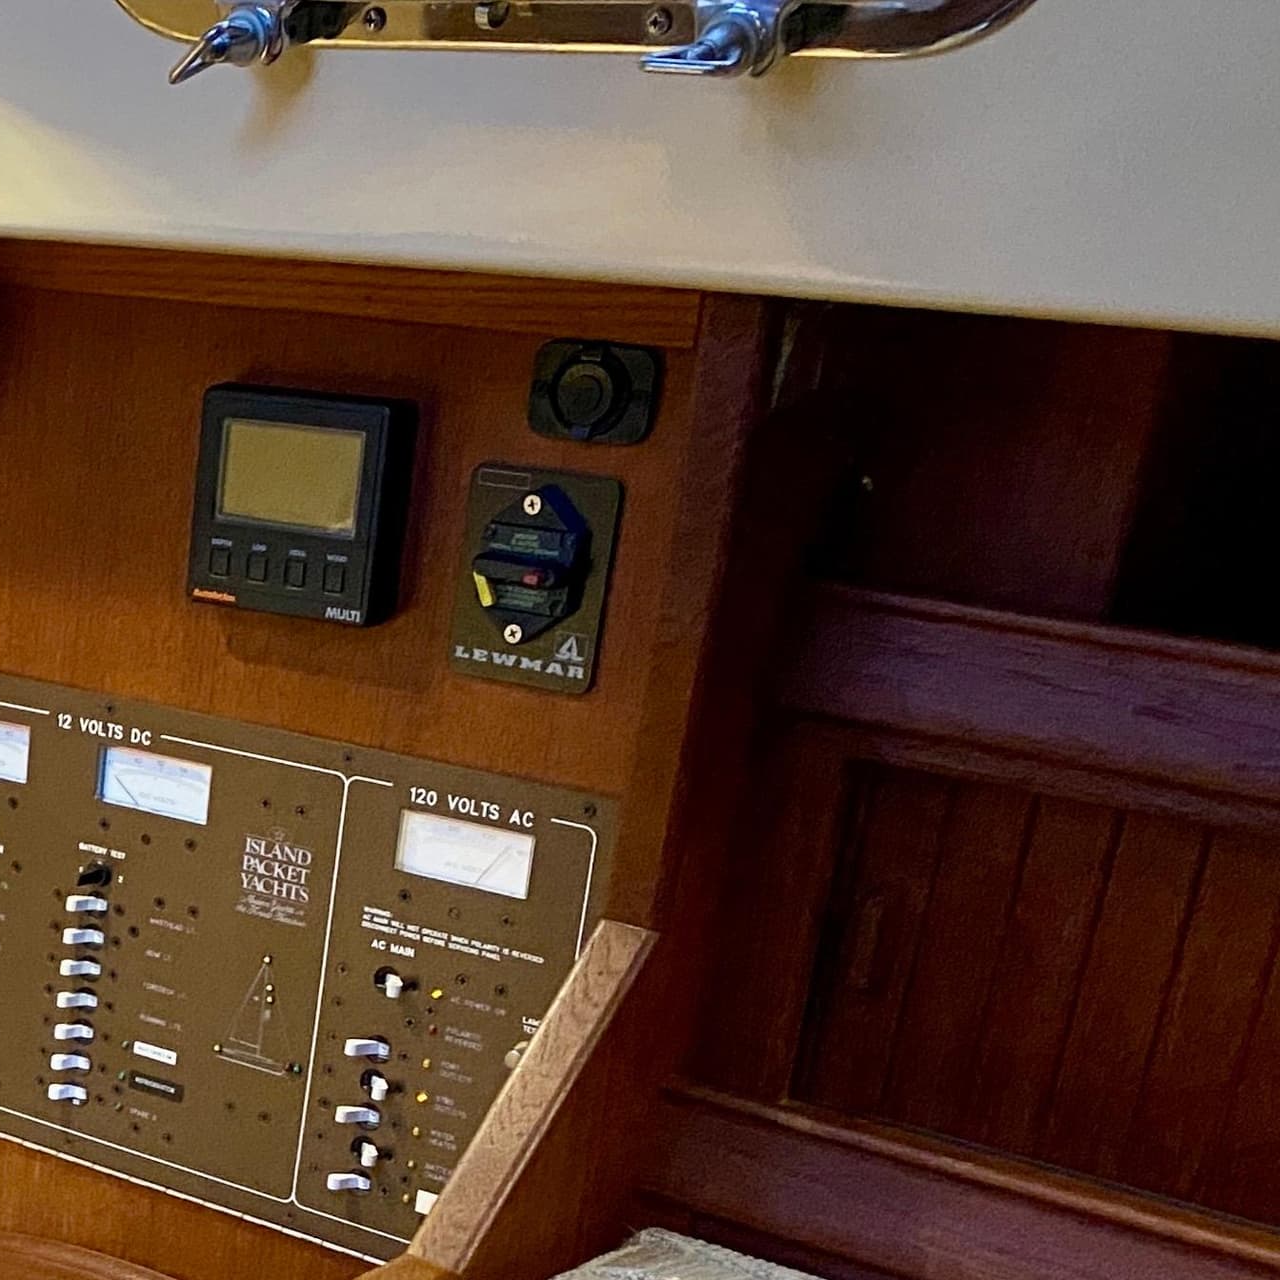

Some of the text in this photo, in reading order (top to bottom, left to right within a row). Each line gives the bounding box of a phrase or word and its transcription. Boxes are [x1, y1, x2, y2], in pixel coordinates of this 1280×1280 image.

[325, 606, 361, 623] MULTI
[454, 645, 585, 679] LEWMAR
[57, 713, 153, 747] 12 VOLTS DC
[409, 786, 535, 829] 120 VOLTS AC
[245, 836, 312, 866] ISLAND
[243, 854, 311, 885] PACKET
[240, 872, 309, 904] YACHTS
[371, 939, 415, 958] AC MAIN
